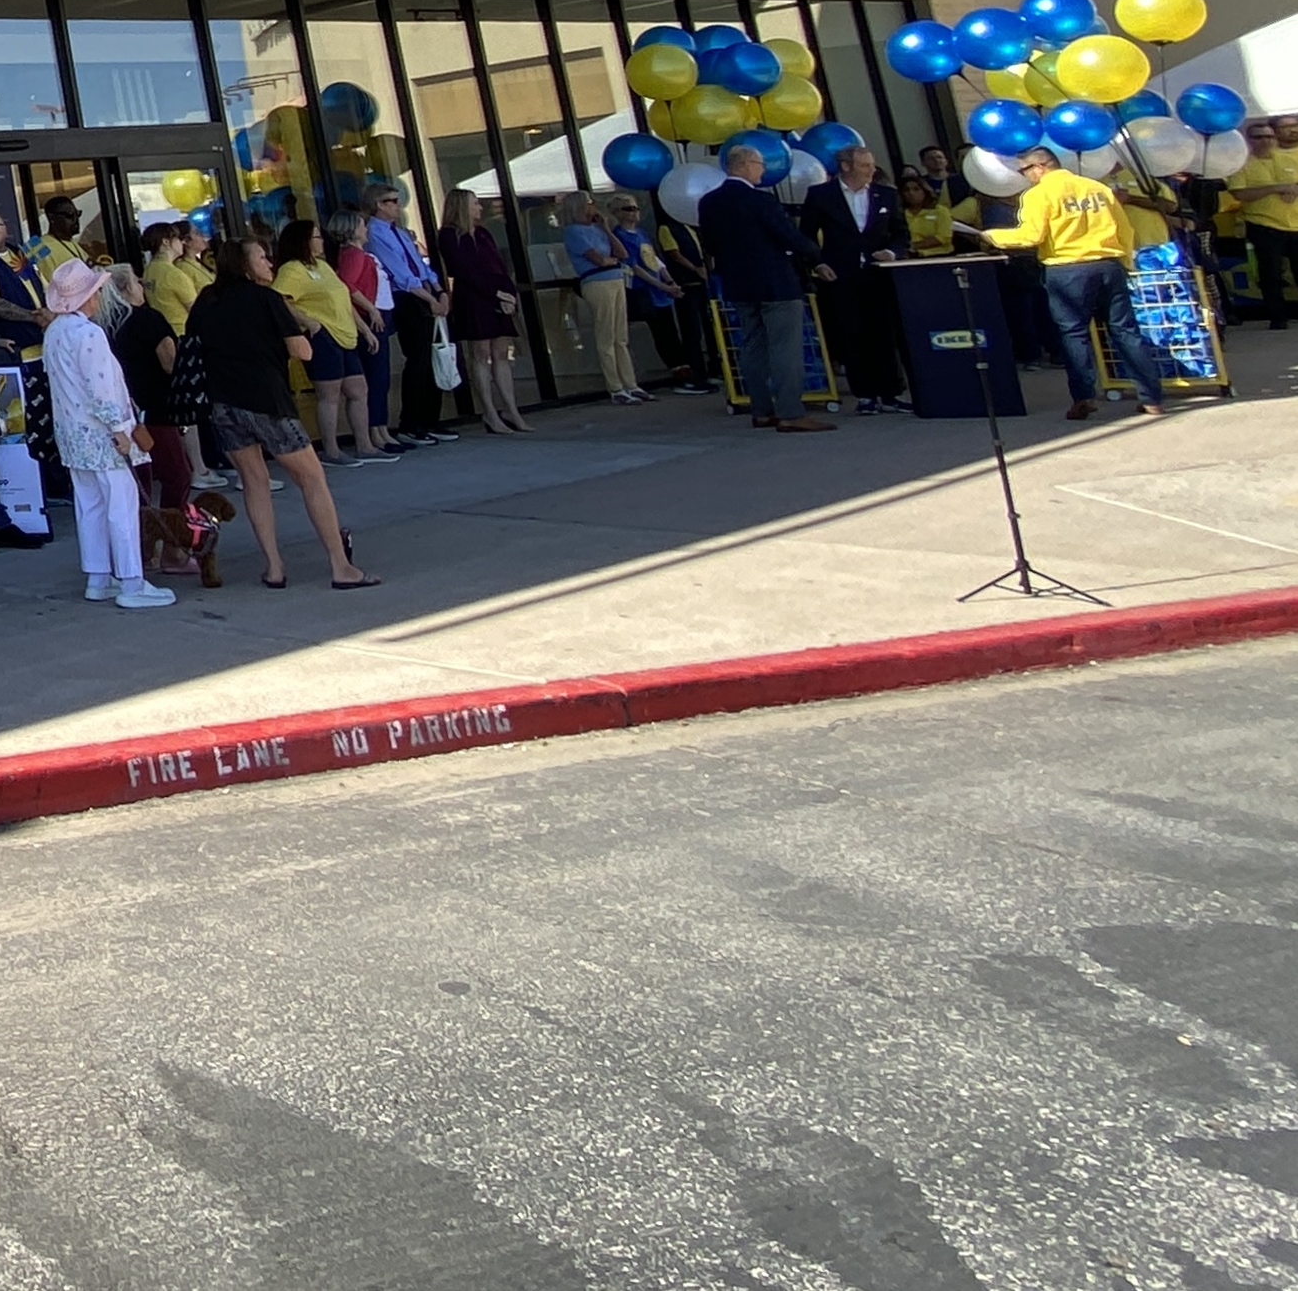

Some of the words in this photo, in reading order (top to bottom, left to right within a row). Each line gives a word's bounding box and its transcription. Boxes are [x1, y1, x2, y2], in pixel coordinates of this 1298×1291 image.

[126, 750, 197, 789] FIRE
[213, 736, 291, 777] LANE
[331, 726, 370, 758] NO
[385, 704, 512, 750] PARKING
